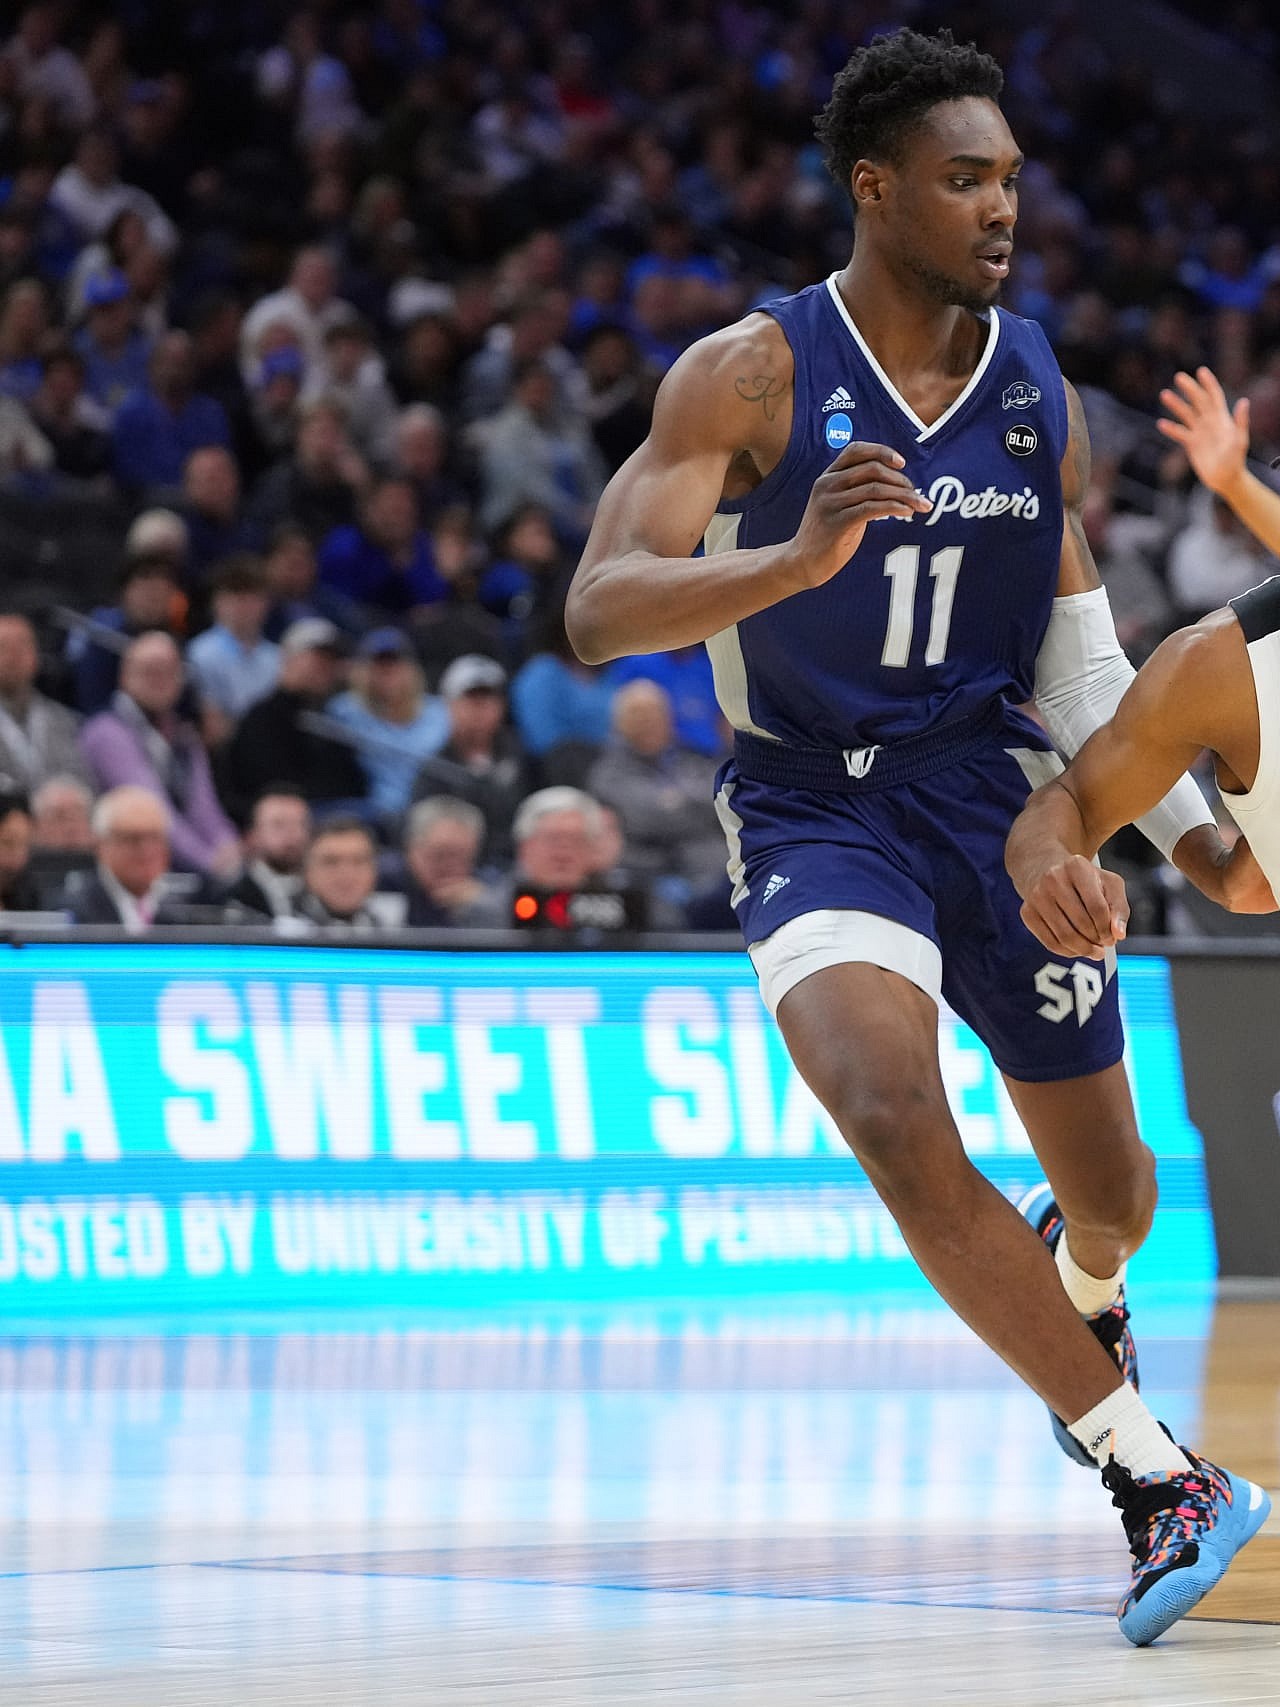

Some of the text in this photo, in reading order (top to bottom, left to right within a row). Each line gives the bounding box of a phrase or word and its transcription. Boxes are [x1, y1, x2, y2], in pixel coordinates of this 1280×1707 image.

[821, 400, 856, 413] adidas
[1008, 432, 1035, 449] BLM
[924, 475, 1040, 526] Peter's
[880, 545, 964, 668] 11
[156, 980, 600, 1162] SWEET
[180, 1191, 257, 1277] BY
[271, 1188, 587, 1275] UNIVERSITY
